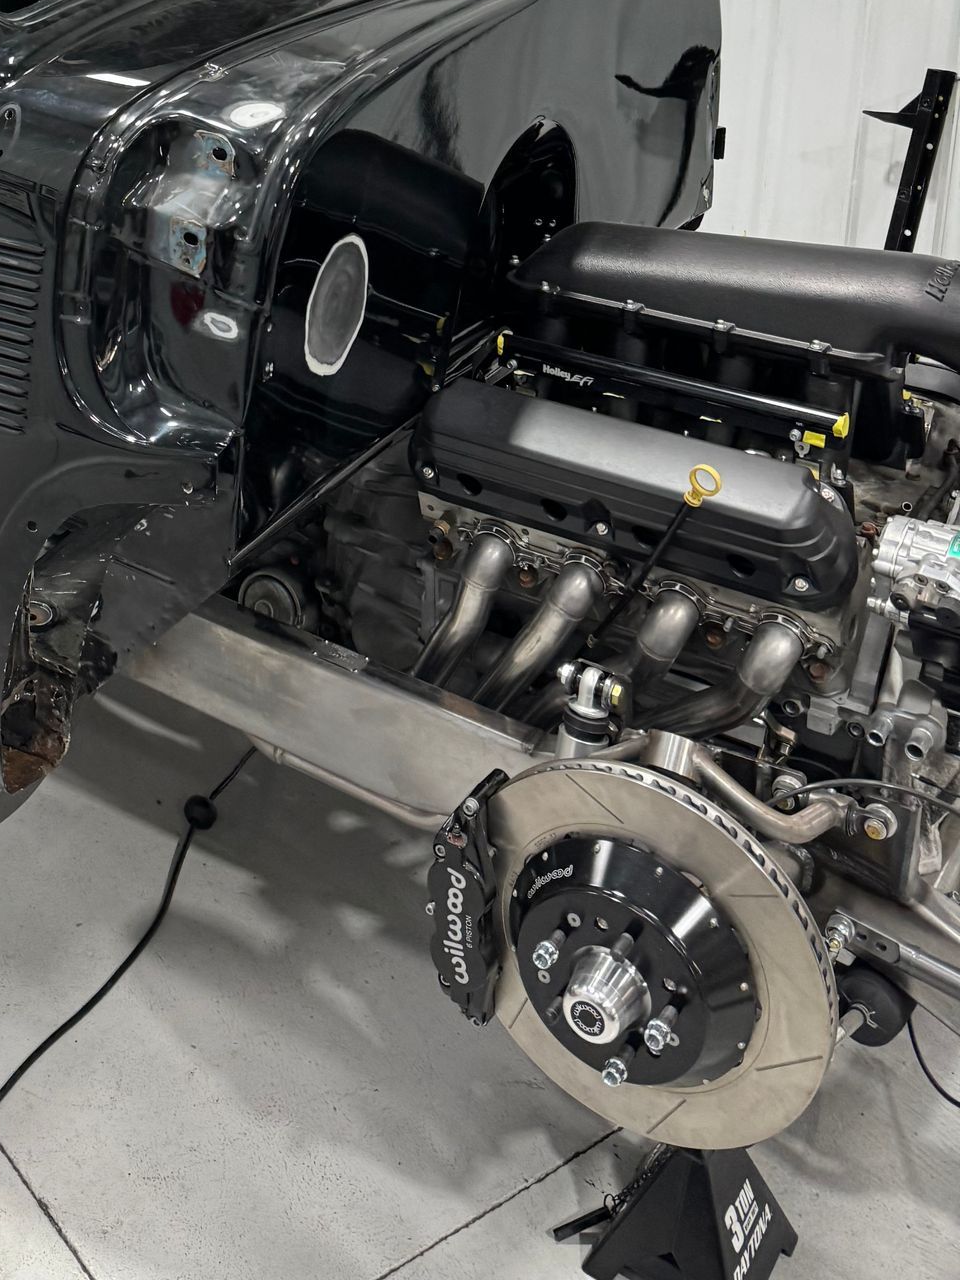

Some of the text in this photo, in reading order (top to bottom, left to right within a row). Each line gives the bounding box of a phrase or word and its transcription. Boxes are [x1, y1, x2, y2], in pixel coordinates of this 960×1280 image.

[542, 363, 571, 382] Holley
[527, 864, 574, 899] wilwood
[443, 866, 471, 985] wilwood
[467, 940, 473, 948] 6
[734, 1178, 755, 1222] TON
[724, 1204, 745, 1254] 3
[733, 1203, 772, 1280] DAYTONA
